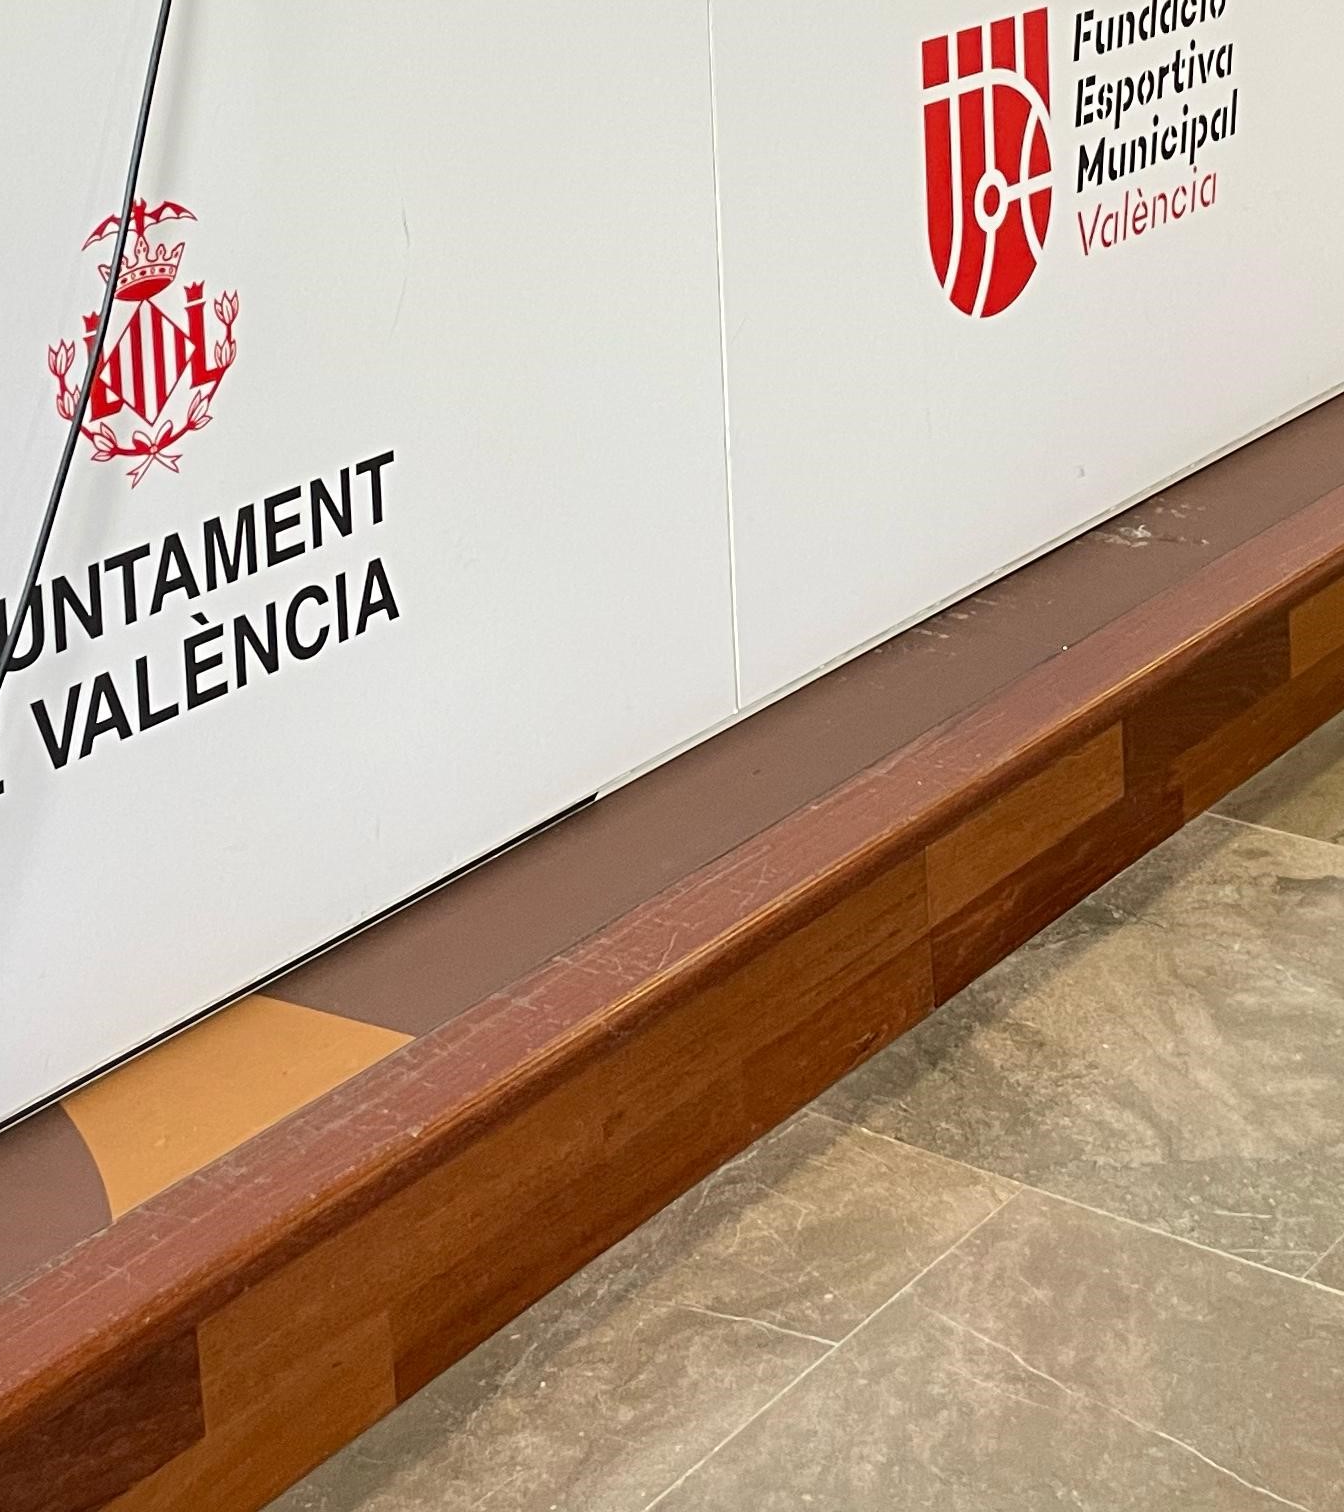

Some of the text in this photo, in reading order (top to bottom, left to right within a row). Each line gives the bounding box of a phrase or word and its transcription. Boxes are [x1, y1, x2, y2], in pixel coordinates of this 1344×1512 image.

[1074, 39, 1234, 129] Esportiva
[1076, 88, 1238, 194] Municipal
[1077, 166, 1218, 256] València
[31, 557, 401, 770] VALÈNCIA
